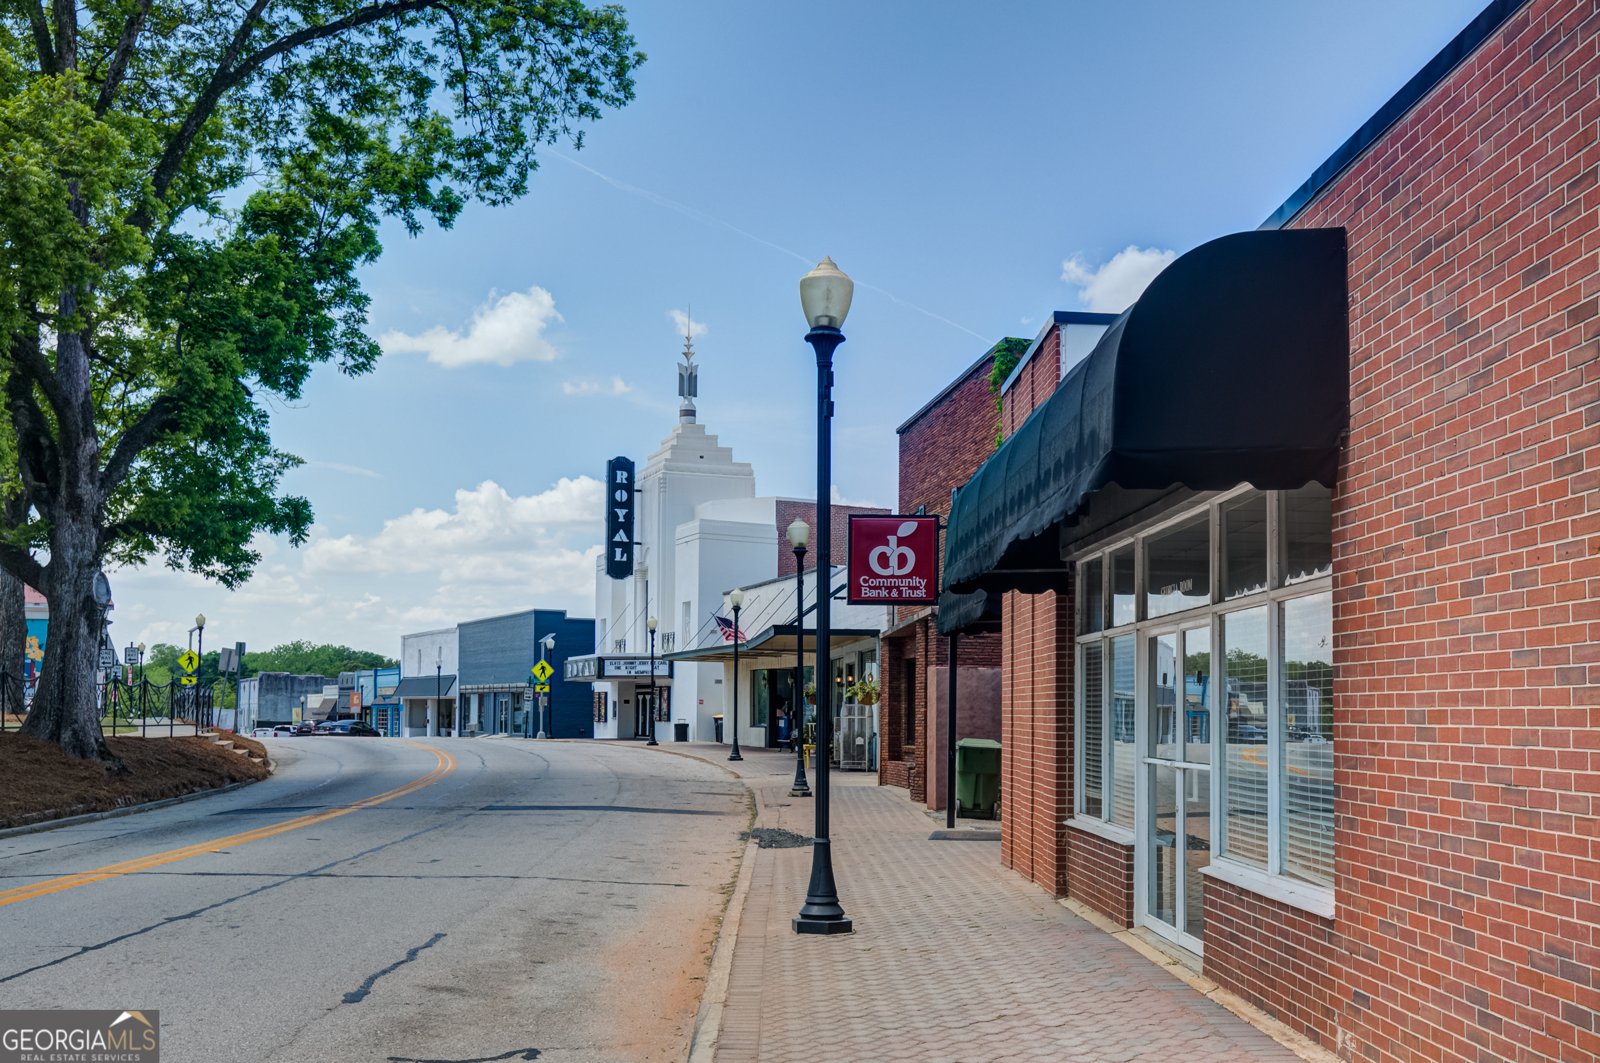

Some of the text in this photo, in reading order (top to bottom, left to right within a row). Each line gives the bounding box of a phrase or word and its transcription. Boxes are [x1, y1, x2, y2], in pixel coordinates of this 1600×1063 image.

[612, 470, 630, 562] ROYAL
[859, 576, 927, 589] Community
[861, 587, 927, 598] Bank & Trust
